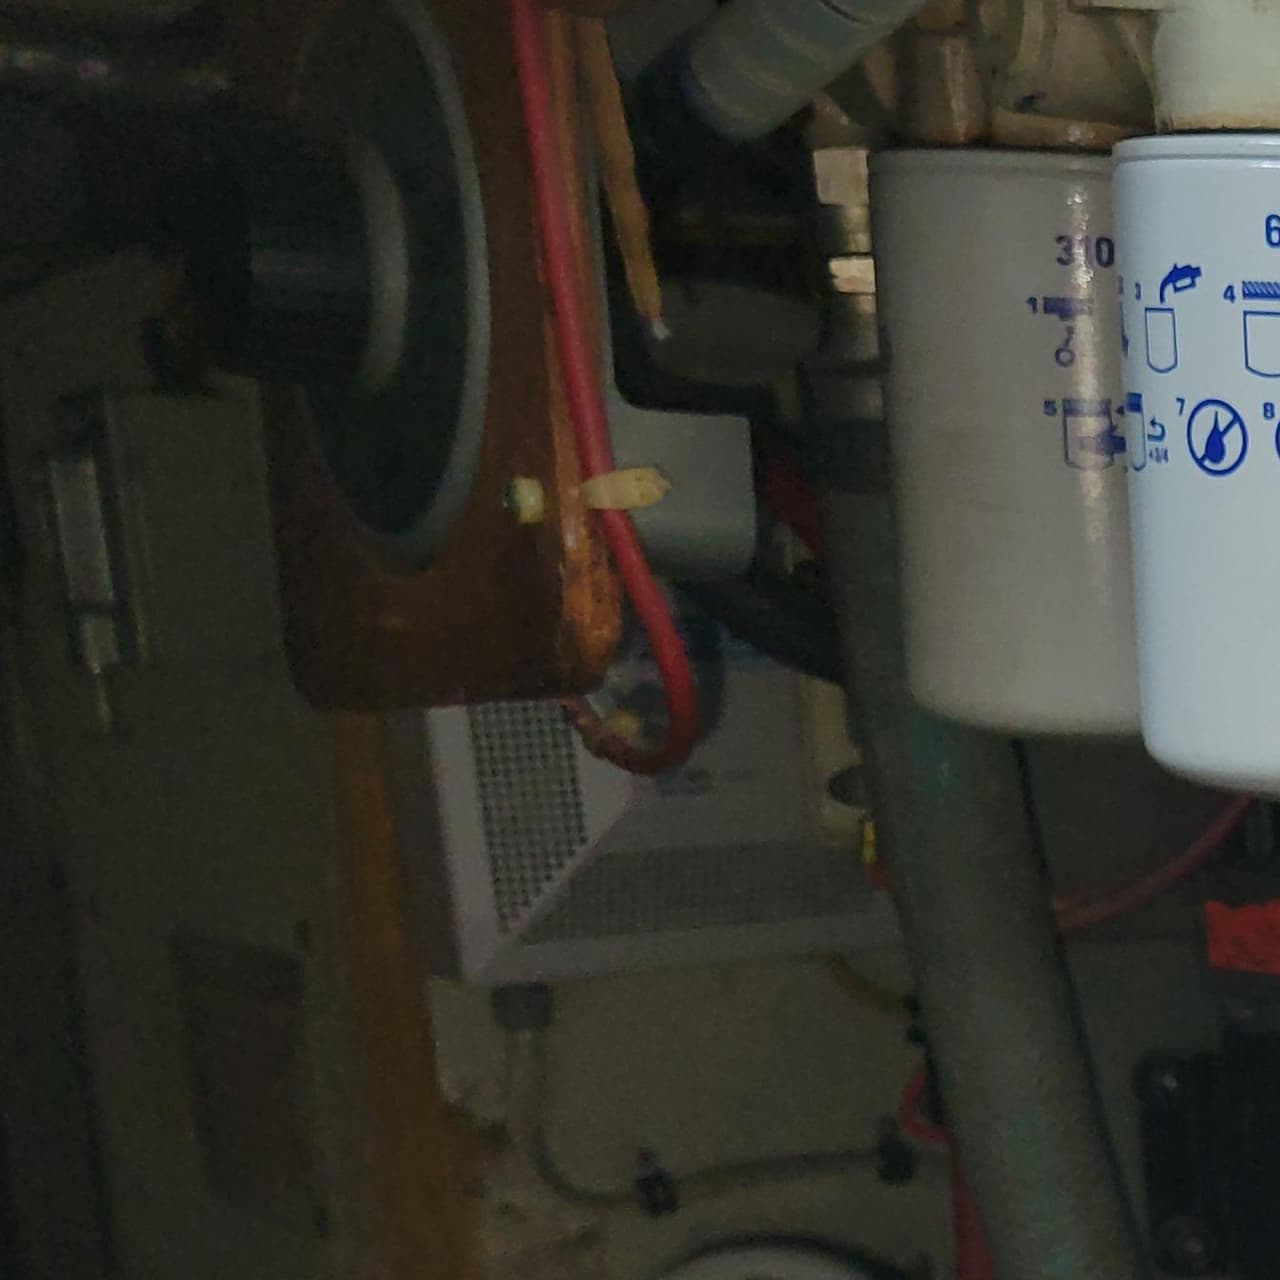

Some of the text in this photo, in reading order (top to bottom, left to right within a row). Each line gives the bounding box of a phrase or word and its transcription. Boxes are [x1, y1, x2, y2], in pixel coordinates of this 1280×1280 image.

[1223, 284, 1236, 302] 4
[1175, 396, 1186, 416] 7
[1262, 402, 1275, 420] 8
